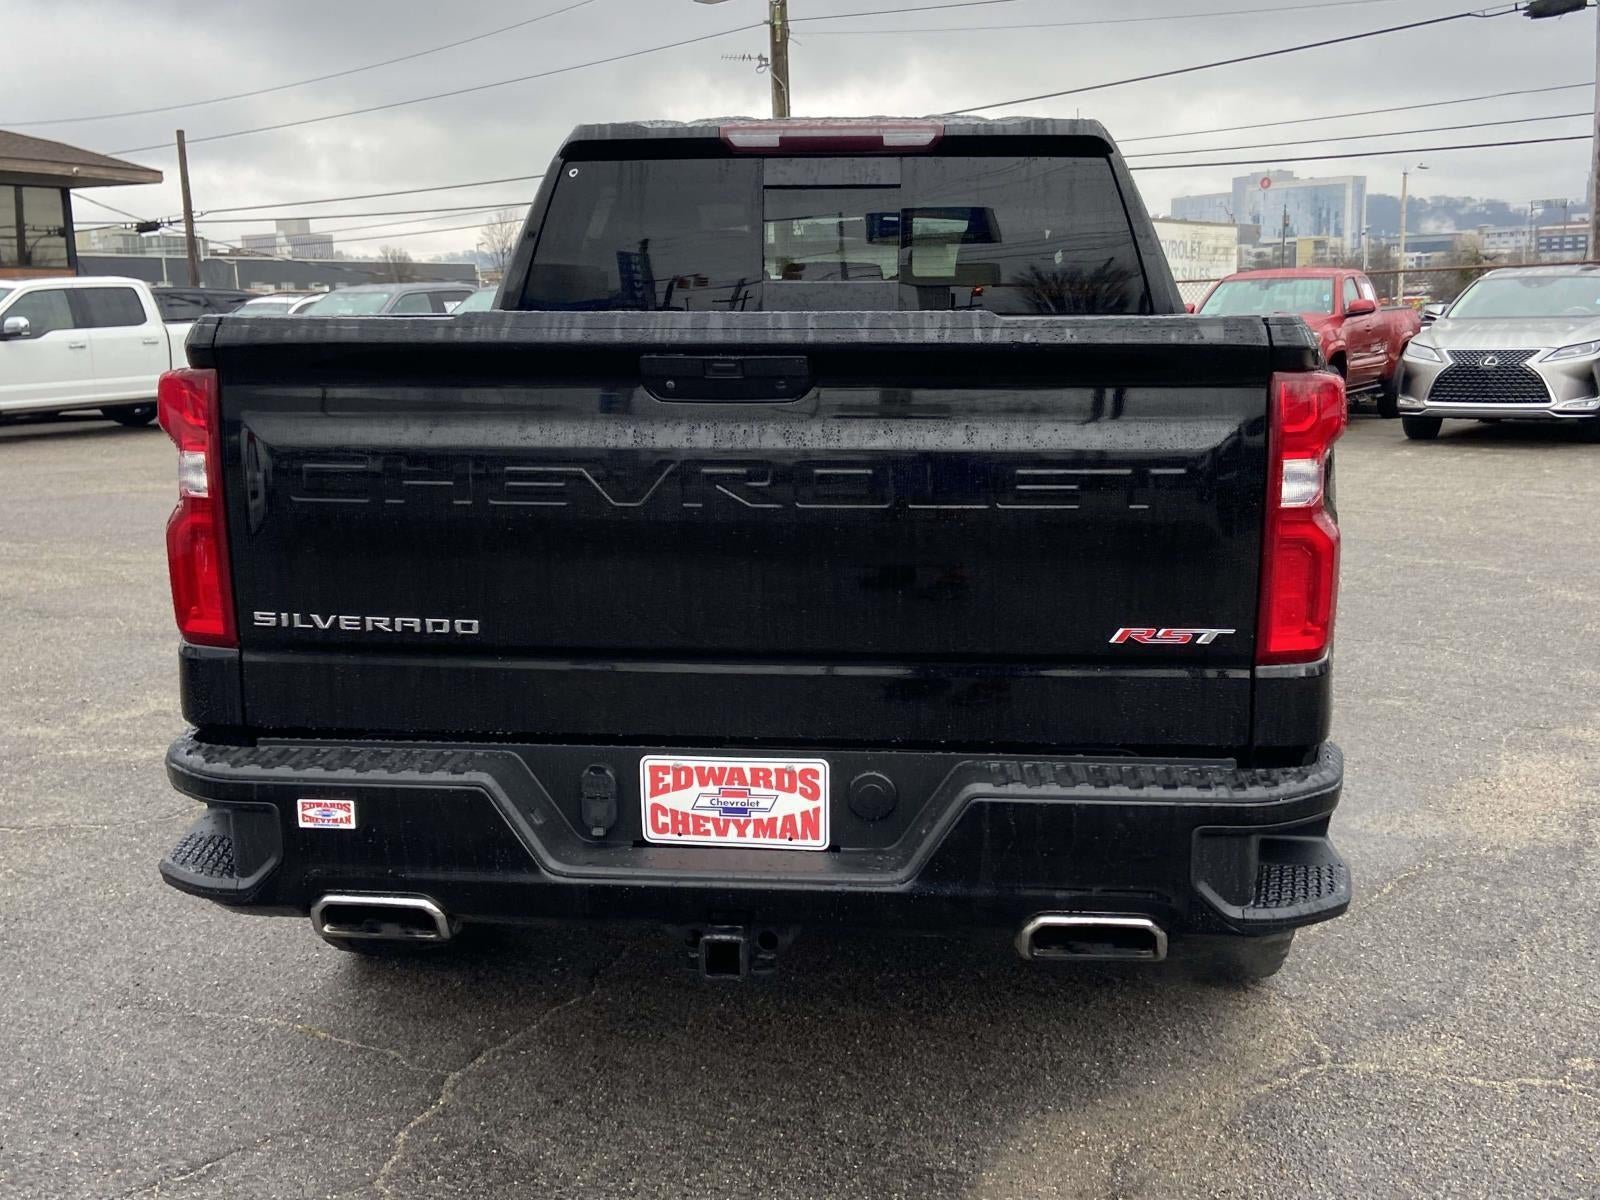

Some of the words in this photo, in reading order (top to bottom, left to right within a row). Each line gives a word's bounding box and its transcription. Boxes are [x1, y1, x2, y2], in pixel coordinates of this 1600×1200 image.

[290, 459, 1187, 508] CHEVROLET
[253, 611, 480, 635] SILVERADO
[1108, 627, 1236, 645] RST
[649, 765, 821, 801] EDWARDS
[301, 802, 351, 813] EDWARDS
[709, 798, 760, 808] Chevrolet
[301, 813, 351, 824] CHEVYMAN
[650, 802, 820, 840] CHEVYMAN
